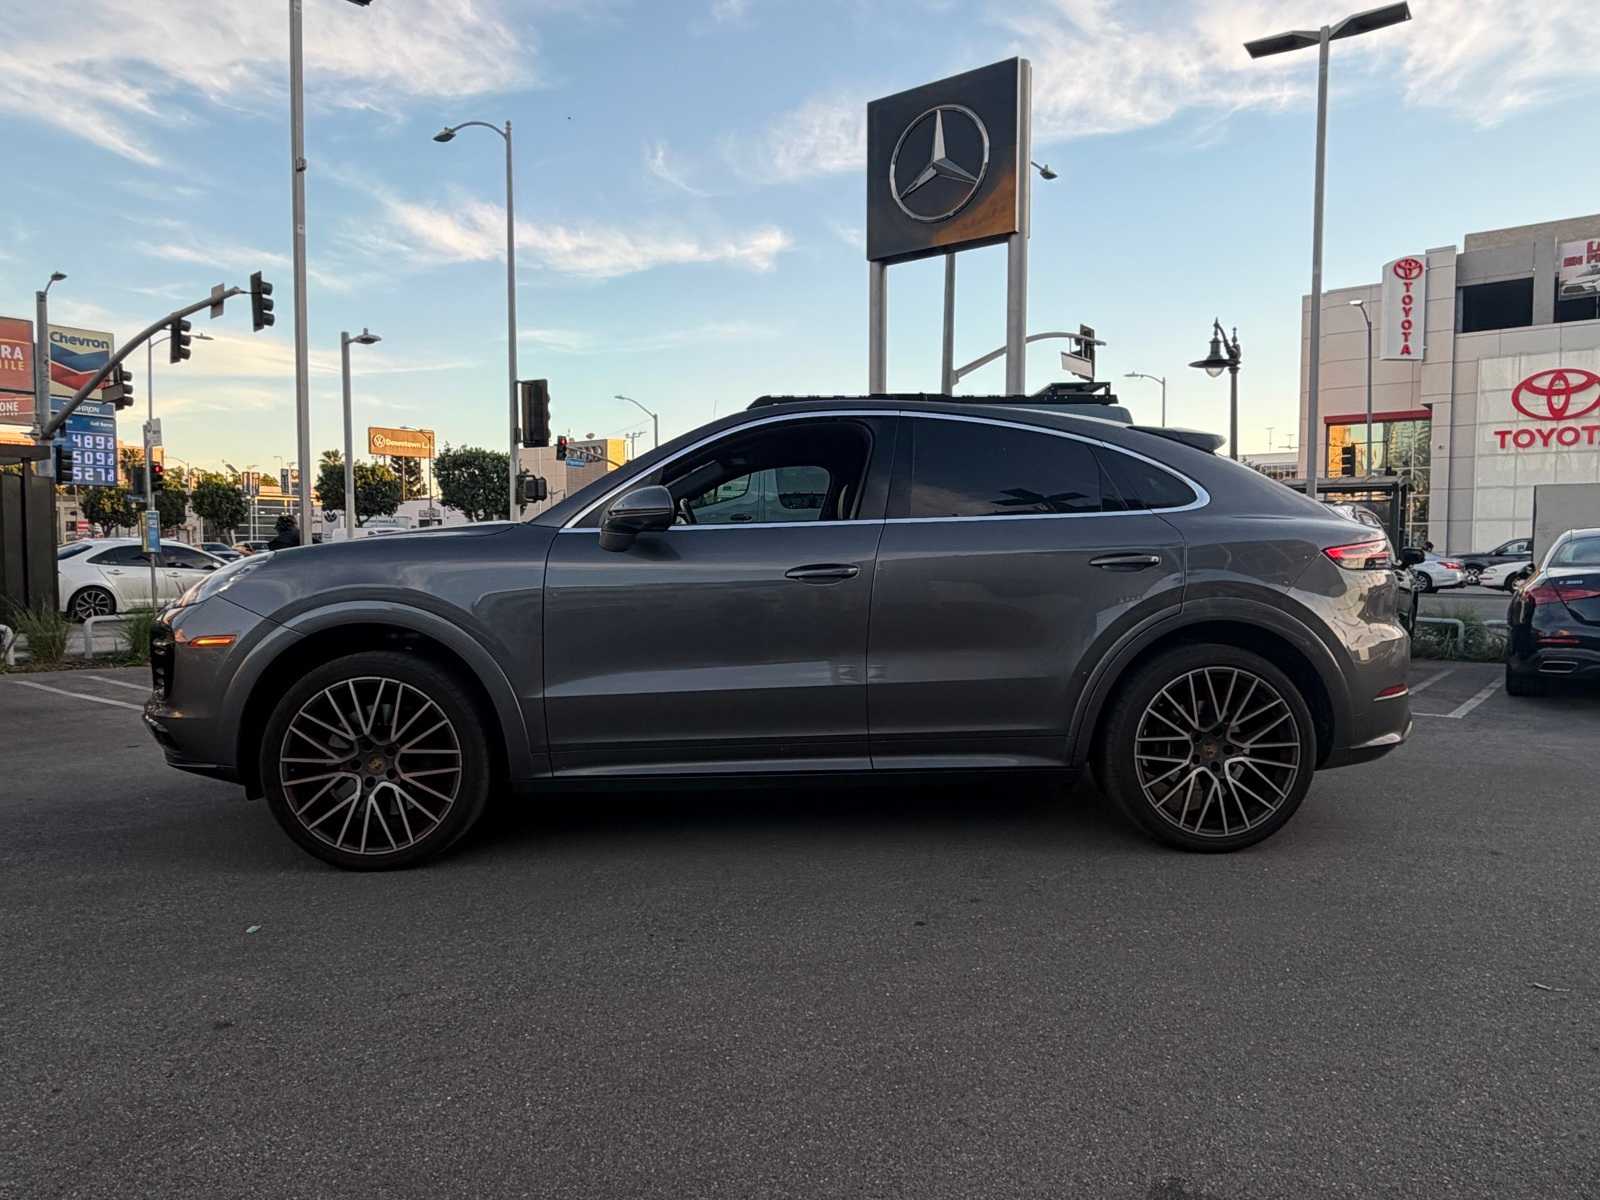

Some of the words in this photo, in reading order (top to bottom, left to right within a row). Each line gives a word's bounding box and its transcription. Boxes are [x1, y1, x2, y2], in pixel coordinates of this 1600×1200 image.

[1400, 282, 1413, 355] TOYOTA
[49, 331, 110, 349] Chevron
[0, 358, 25, 371] ILE
[385, 438, 421, 449] Downtown
[1494, 425, 1600, 449] TOYOT
